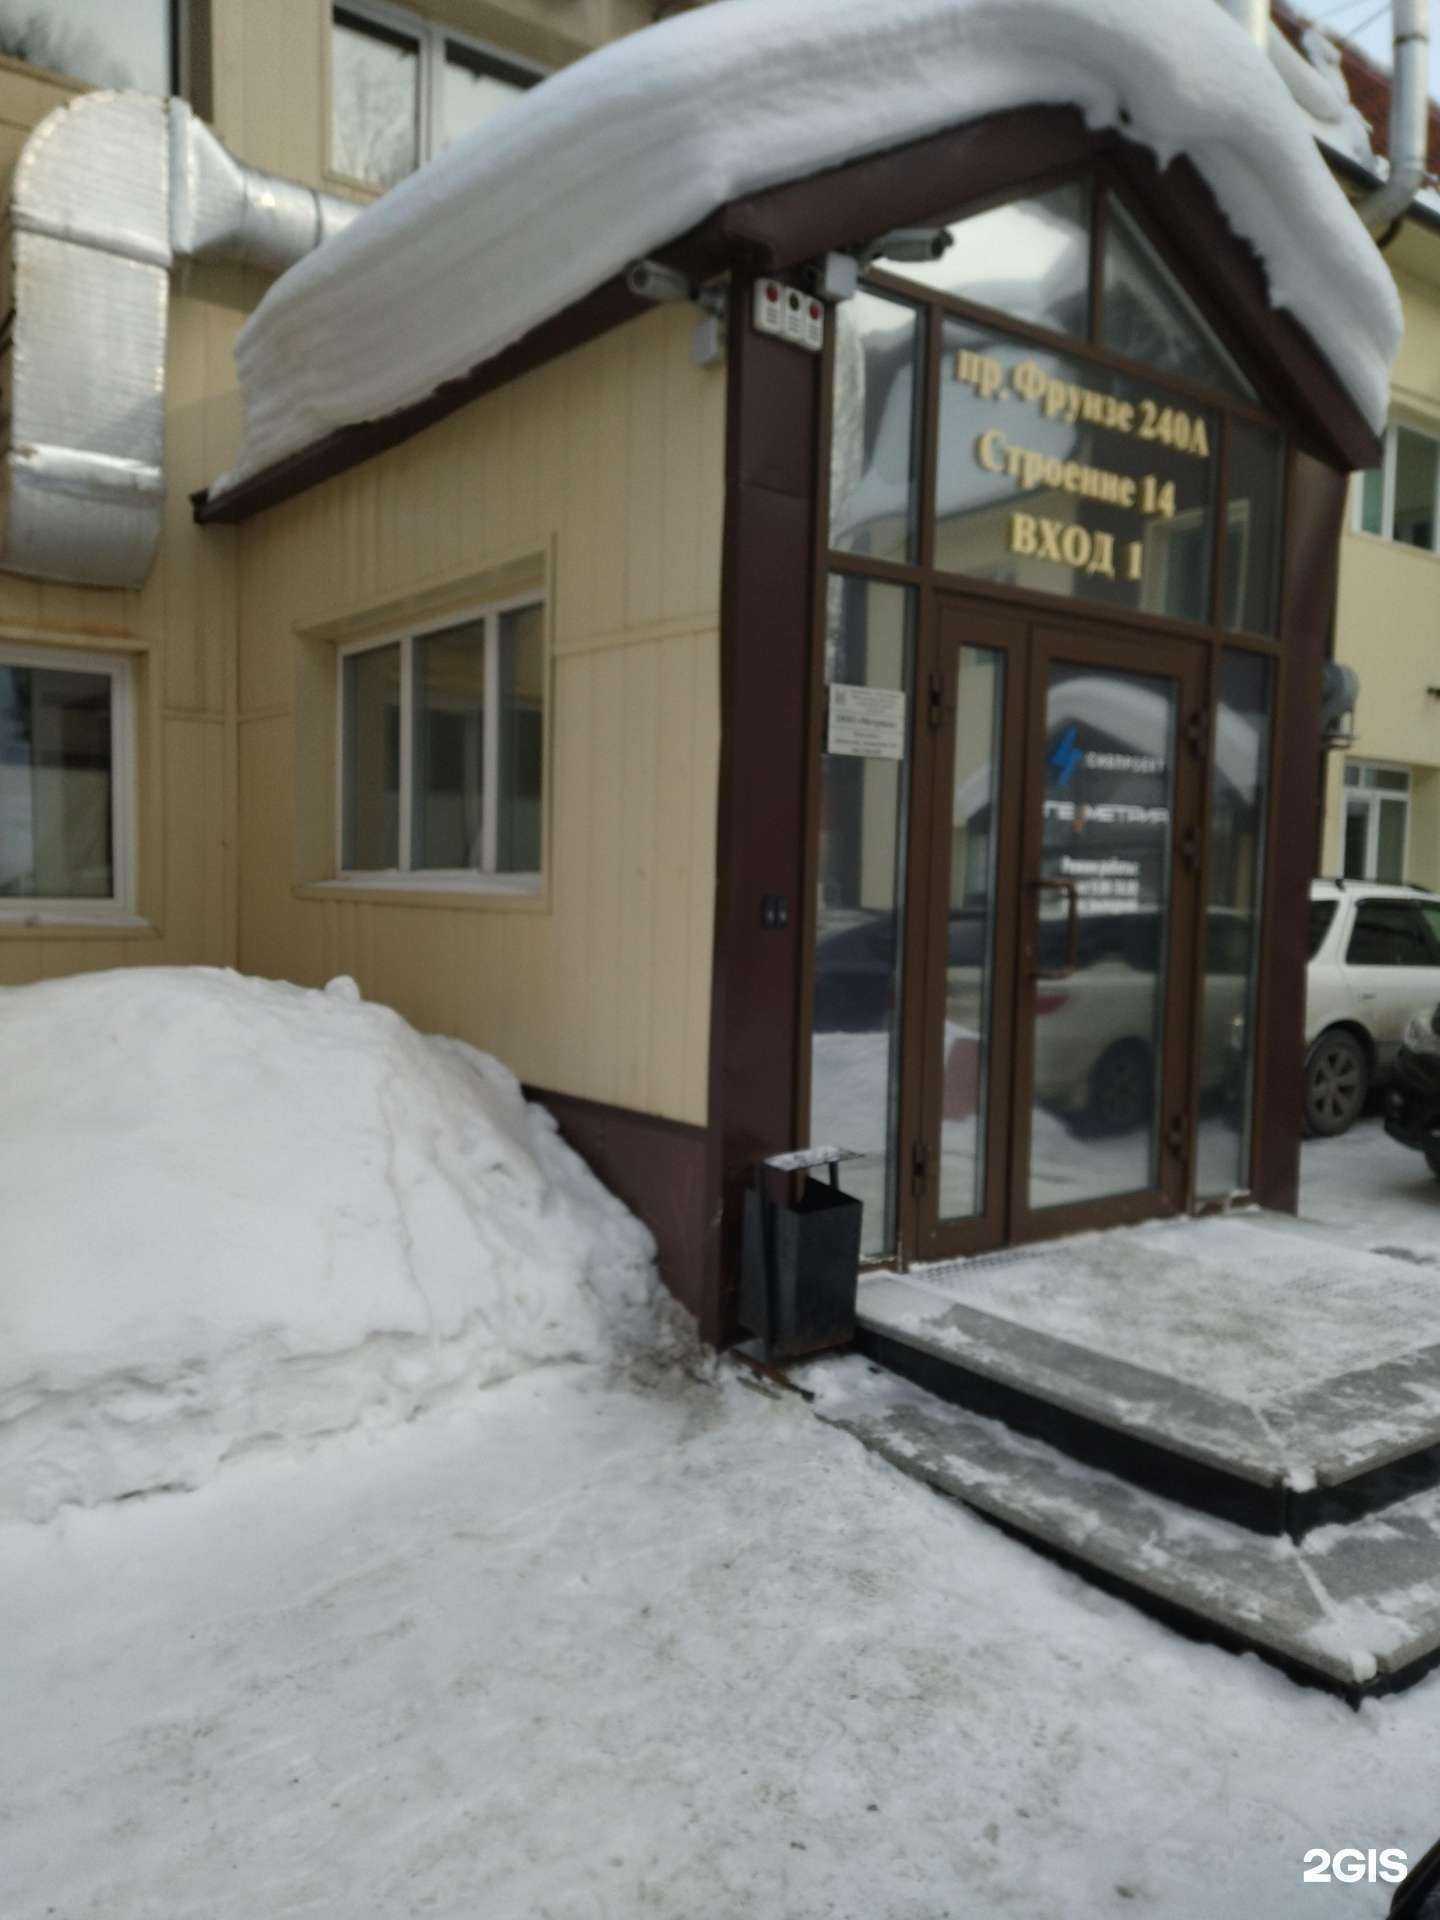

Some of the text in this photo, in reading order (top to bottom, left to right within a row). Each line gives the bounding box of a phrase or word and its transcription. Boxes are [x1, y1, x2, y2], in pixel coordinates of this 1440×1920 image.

[956, 349, 1209, 458] пр. Фрунзе 240А
[977, 428, 1176, 520] Строение 14
[1011, 512, 1115, 577] ВХОД
